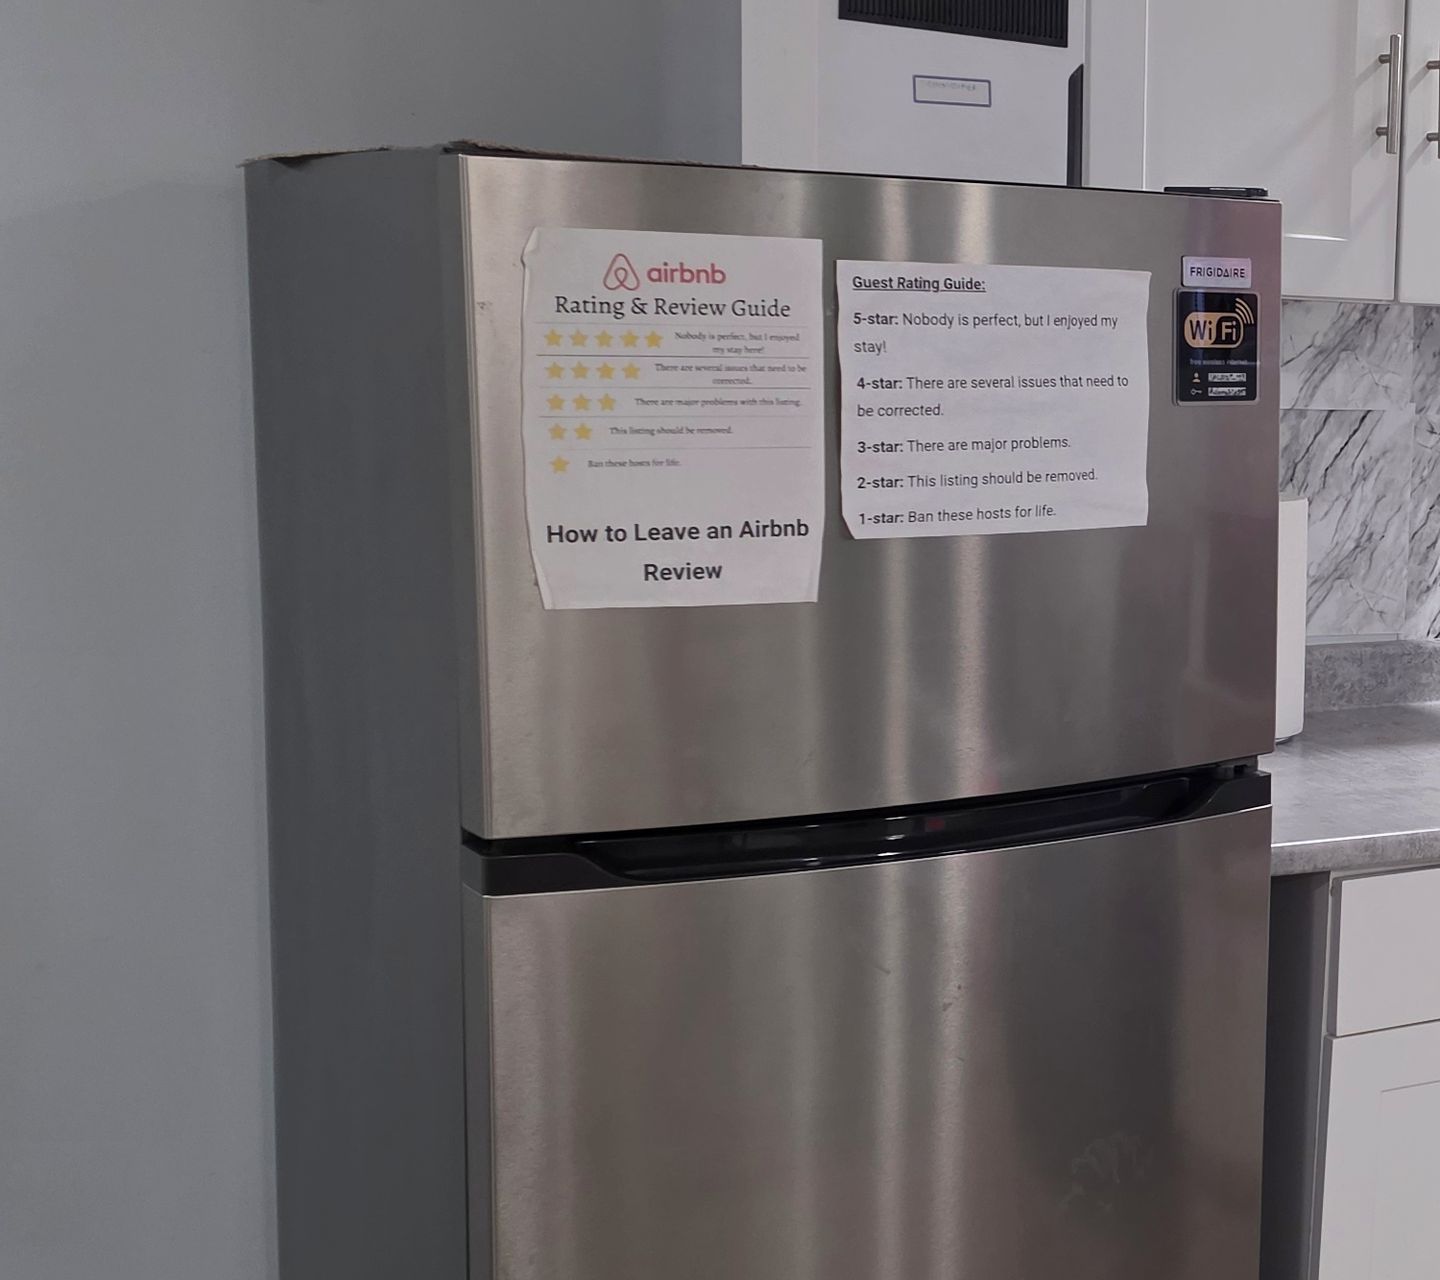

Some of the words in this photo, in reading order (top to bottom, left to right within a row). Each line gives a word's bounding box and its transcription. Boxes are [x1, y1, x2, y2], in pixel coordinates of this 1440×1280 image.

[646, 262, 727, 285] airbnb
[1190, 266, 1246, 278] FRIGIDAIRE
[852, 276, 894, 291] Guest
[897, 276, 941, 293] Rating
[943, 277, 987, 292] Guide:
[554, 296, 625, 319] Rating
[632, 298, 649, 315] &
[653, 297, 726, 317] Review
[731, 299, 792, 319] Guide
[853, 312, 900, 326] 5-star:
[902, 312, 954, 330] Nobody
[958, 313, 969, 327] is
[972, 312, 1022, 331] perfect,
[1024, 314, 1044, 327] but
[1053, 314, 1098, 331] enjoyed
[1101, 317, 1118, 330] my
[675, 332, 706, 342] Nobody
[749, 333, 762, 341] but
[769, 333, 800, 343] enjoyed
[726, 345, 742, 354] stay
[853, 339, 888, 357] stay!
[655, 363, 678, 372] There
[750, 364, 765, 372] that
[768, 364, 786, 372] need
[797, 365, 807, 373] be
[857, 375, 903, 390] 4-star:
[906, 375, 942, 389] There
[947, 377, 967, 389] are
[971, 375, 1015, 388] several
[1018, 375, 1057, 388] issues
[1059, 374, 1083, 388] that
[1086, 374, 1114, 388] need
[1116, 375, 1129, 387] to
[634, 397, 658, 406] There
[857, 403, 874, 417] be
[878, 403, 944, 417] corrected.
[610, 426, 627, 435] This
[629, 426, 655, 437] listing
[657, 426, 684, 435] should
[686, 426, 694, 434] be
[857, 439, 904, 454] 3-star:
[907, 438, 945, 452] There
[948, 440, 968, 452] are
[971, 437, 1008, 455] major
[1011, 435, 1071, 454] problems.
[857, 476, 904, 490] 2-star:
[907, 474, 937, 488] This
[940, 473, 978, 491] listing
[982, 471, 1023, 485] should
[1026, 470, 1042, 484] be
[1045, 468, 1098, 483] removed.
[859, 511, 904, 525] 1-star:
[908, 510, 933, 523] Ban
[937, 508, 974, 522] these
[976, 505, 1012, 520] hosts
[1014, 505, 1033, 519] for
[1035, 504, 1056, 518] life.
[546, 524, 598, 543] How
[605, 526, 627, 543] to
[634, 522, 701, 542] Leave
[707, 524, 732, 540] an
[739, 519, 810, 538] Airbnb
[643, 562, 723, 582] Review
